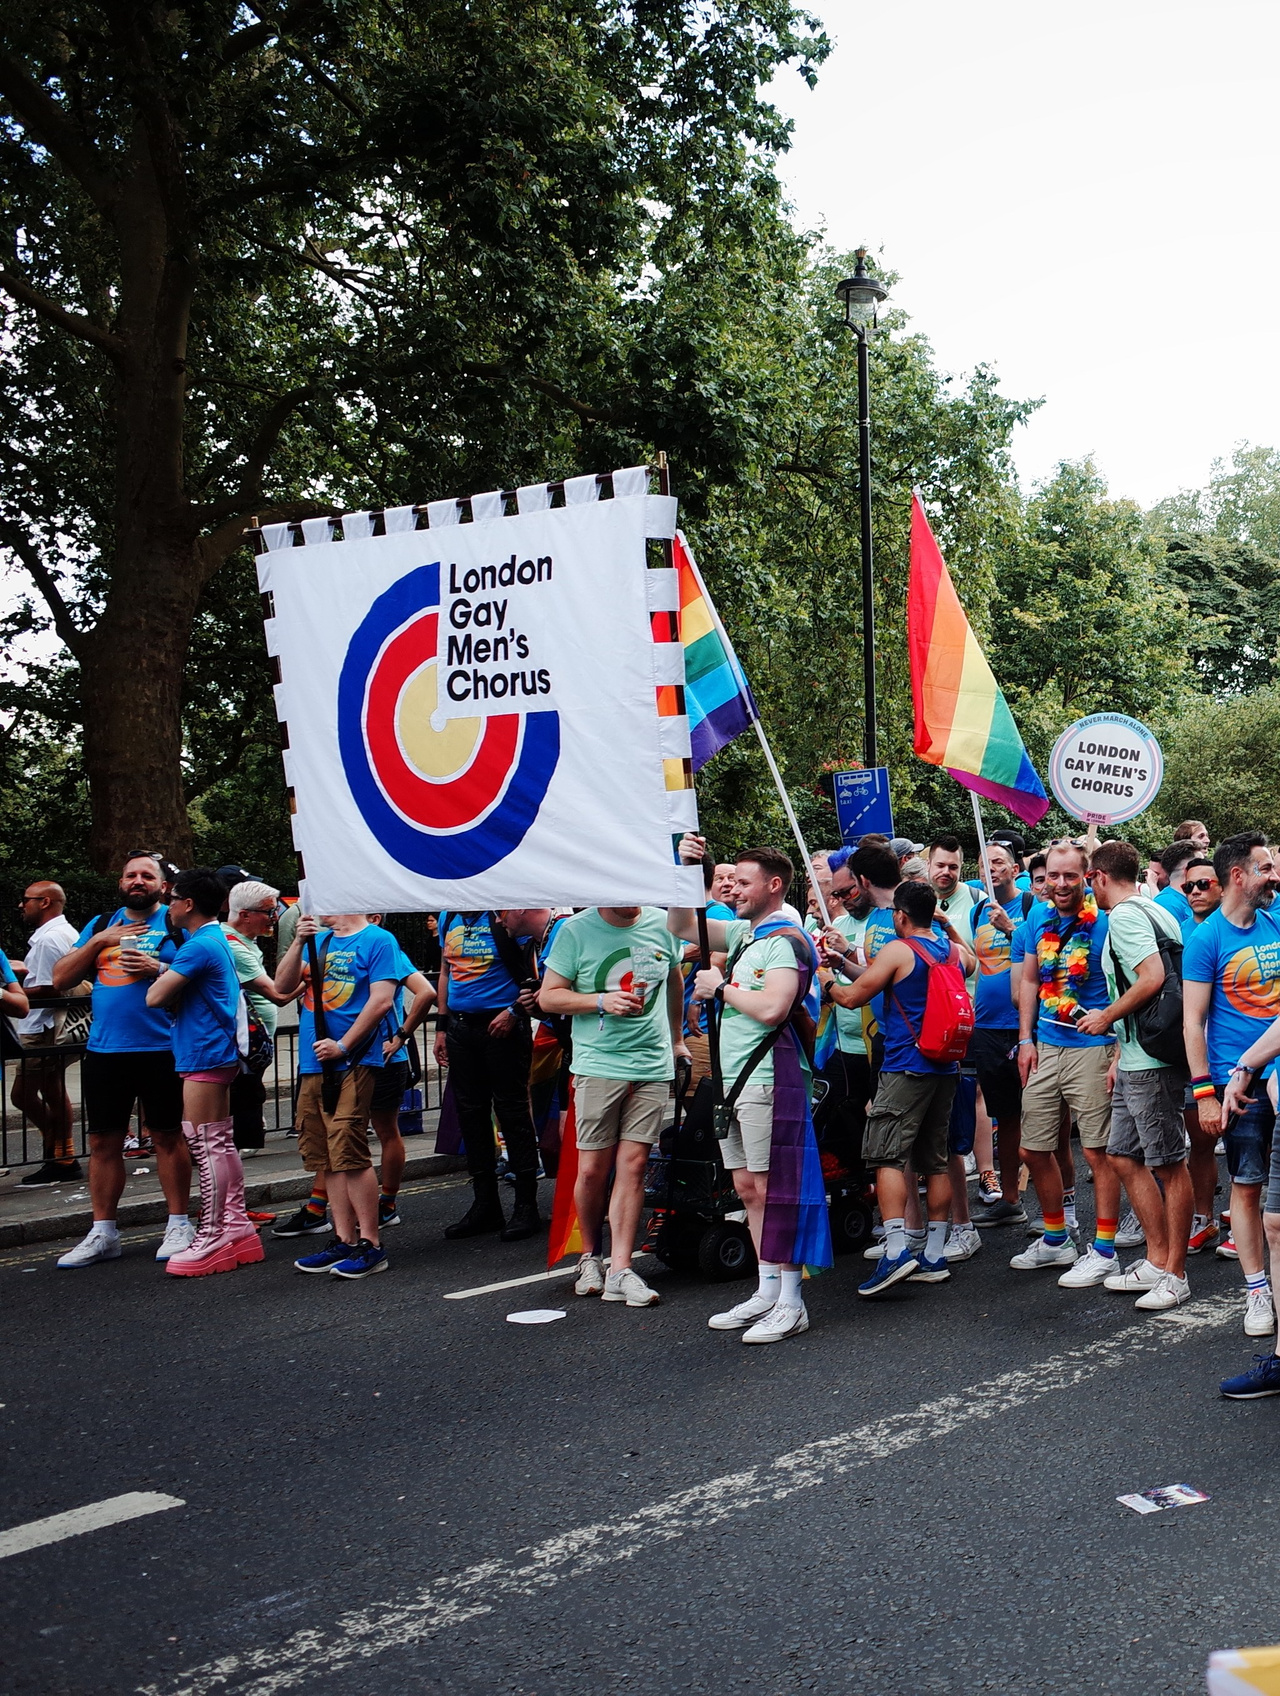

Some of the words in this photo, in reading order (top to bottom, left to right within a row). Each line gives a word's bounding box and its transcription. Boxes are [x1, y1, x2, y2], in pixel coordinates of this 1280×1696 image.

[449, 554, 553, 594] London
[449, 598, 508, 631] Gay
[447, 628, 530, 666] Men's
[446, 668, 551, 702] Chorus
[1079, 716, 1102, 728] NEVER
[1103, 715, 1128, 725] MARCH
[1129, 721, 1148, 738] ALONE
[1078, 741, 1140, 762] LONDON
[1064, 757, 1095, 773] GAY
[1097, 762, 1147, 781] MEN'S
[1071, 777, 1134, 798] CHORUS
[1086, 812, 1106, 820] PRIDE
[463, 947, 493, 955] Chorus
[1258, 951, 1278, 961] Gay
